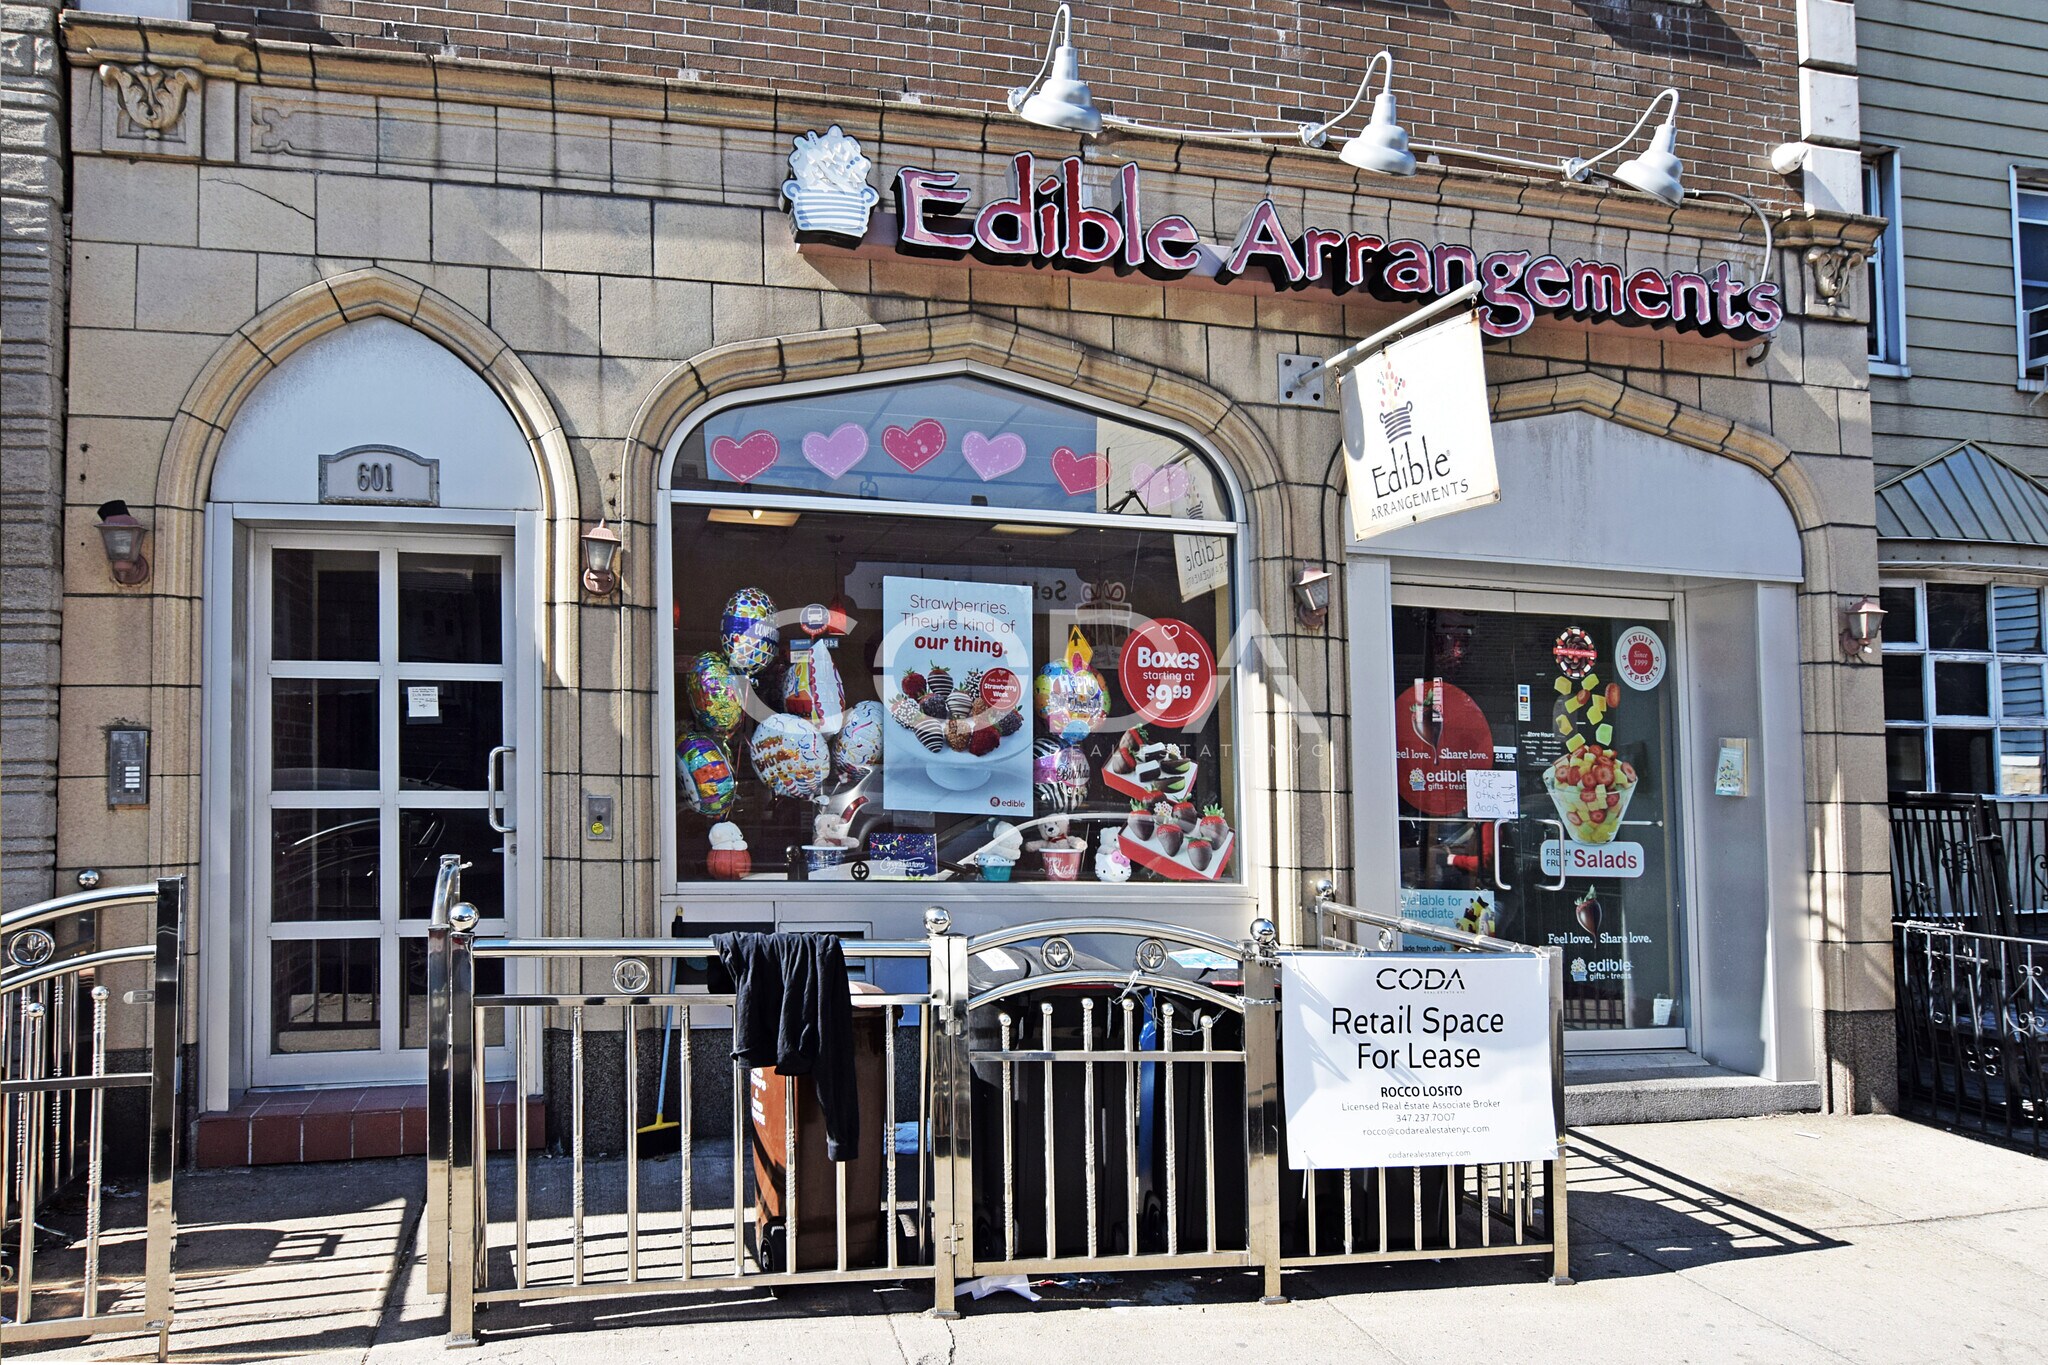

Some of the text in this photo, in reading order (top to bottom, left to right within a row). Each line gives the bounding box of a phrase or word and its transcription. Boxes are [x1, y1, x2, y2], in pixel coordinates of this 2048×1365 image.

[897, 150, 1785, 336] Edible Arrangements
[357, 463, 393, 492] 601
[1371, 478, 1469, 521] ARRANGEMENTS
[910, 594, 1010, 615] Strawberries.
[901, 612, 1015, 634] They're kind of
[914, 635, 1008, 658] our thing.
[1627, 635, 1655, 646] FRUIT
[1137, 646, 1199, 670] Boxes
[1633, 650, 1649, 659] Since
[1142, 670, 1195, 682] starting at
[1624, 664, 1659, 682] EXPERTS
[1397, 748, 1488, 760] eel love. Share love.
[1428, 783, 1444, 791] gifts
[1001, 799, 1026, 808] edible
[1546, 848, 1571, 856] FREH
[1546, 859, 1568, 867] FRUT
[1574, 849, 1637, 869] Salads
[1448, 895, 1462, 906] for
[1548, 932, 1652, 944] Feel love. Share love.
[1588, 959, 1632, 972] edible
[1376, 968, 1465, 990] CODA
[1589, 972, 1606, 981] gifts
[1332, 1005, 1504, 1041] Retail Space
[1357, 1042, 1481, 1069] For Lease
[1380, 1085, 1463, 1098] ROCCO LOSITO
[1341, 1099, 1501, 1111] Licensed Real Estate Associate Broker
[1396, 1112, 1456, 1123] 347.237.7007
[1362, 1125, 1490, 1137] rocco@codarealestatenyc.com
[1388, 1149, 1471, 1160] codarealestatenyc.com
